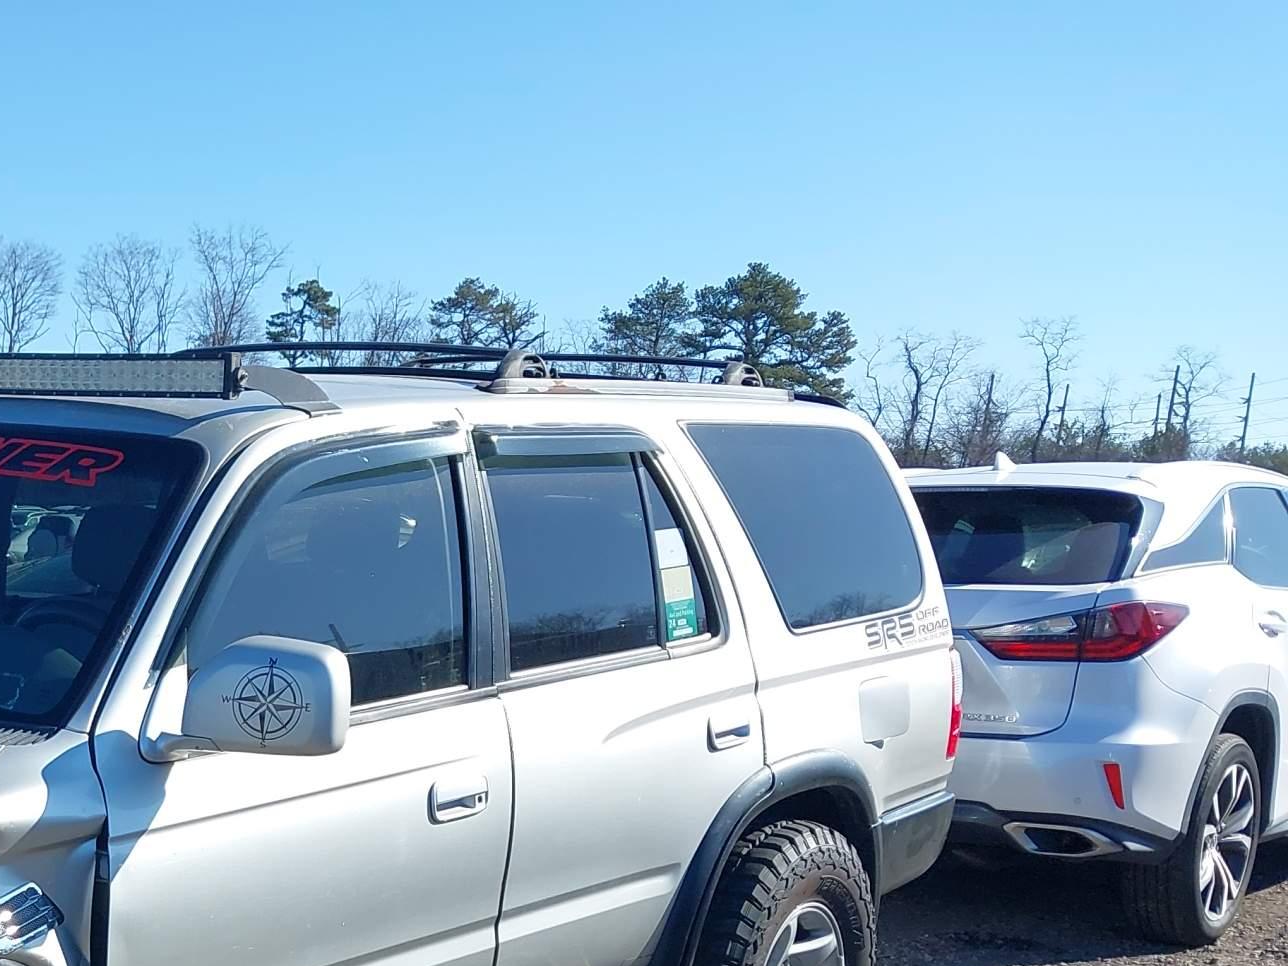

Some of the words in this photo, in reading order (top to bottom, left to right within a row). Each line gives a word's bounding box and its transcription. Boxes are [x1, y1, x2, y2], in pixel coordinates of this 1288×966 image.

[915, 606, 940, 620] OFF
[918, 618, 949, 634] ROAD
[268, 656, 279, 665] N
[222, 694, 232, 704] W
[304, 702, 312, 712] E
